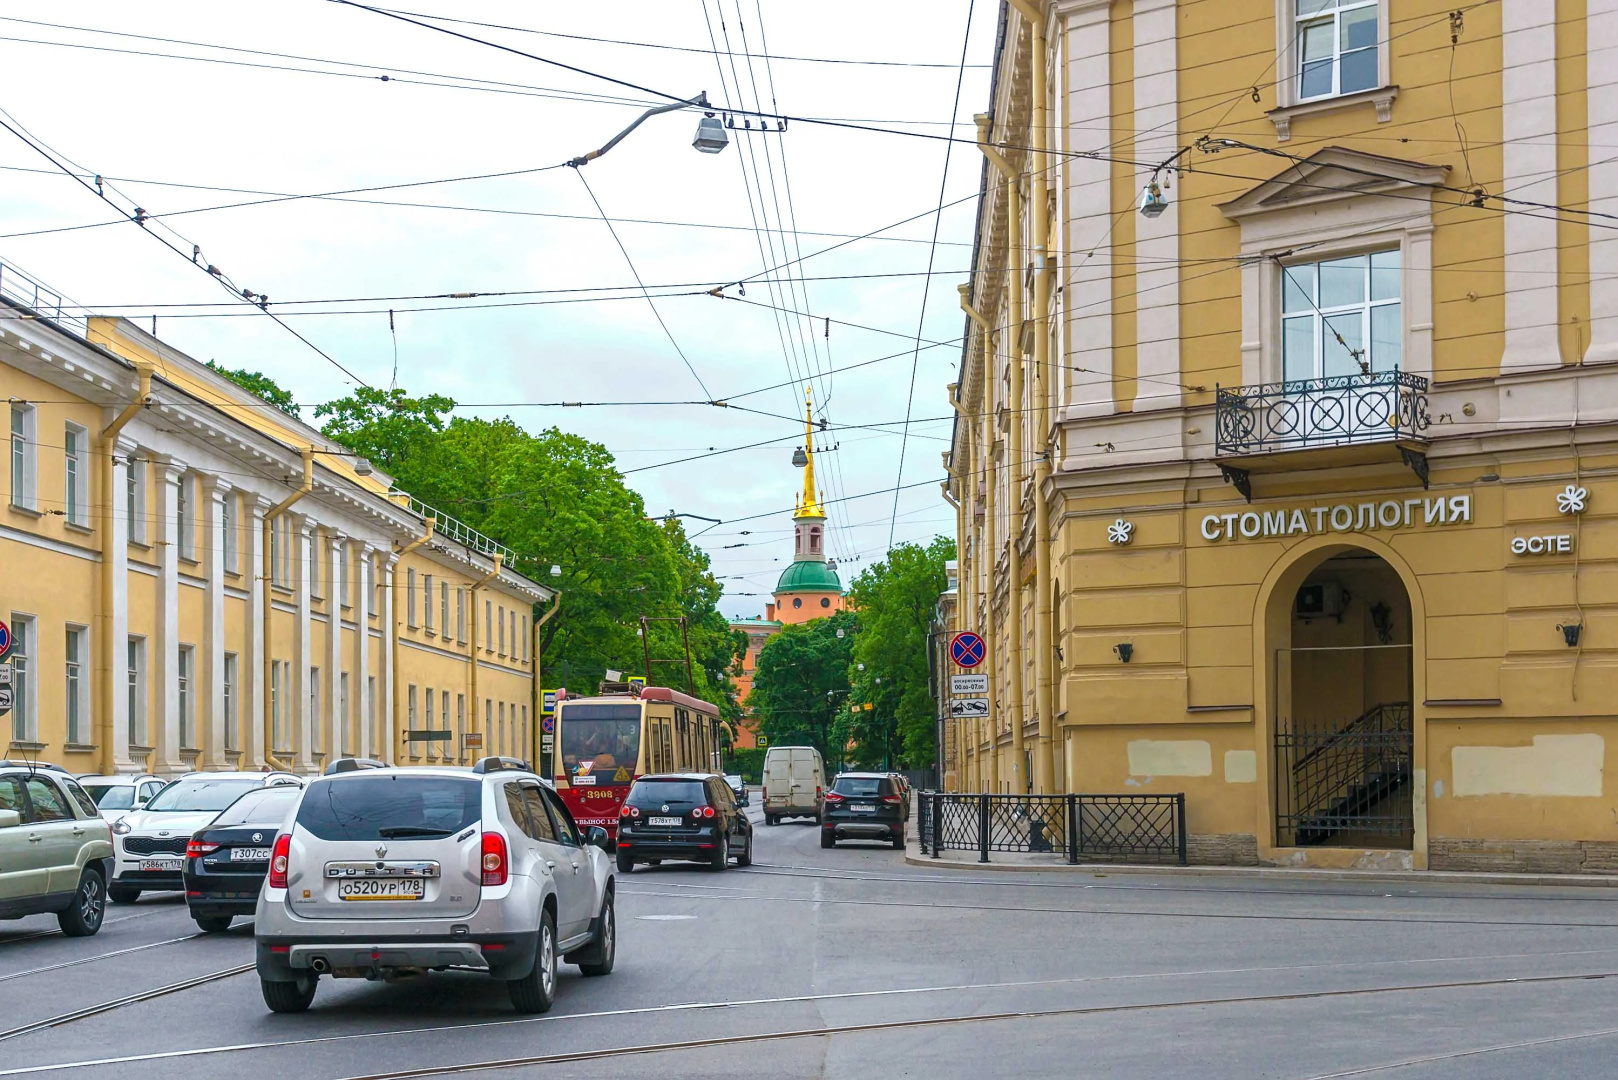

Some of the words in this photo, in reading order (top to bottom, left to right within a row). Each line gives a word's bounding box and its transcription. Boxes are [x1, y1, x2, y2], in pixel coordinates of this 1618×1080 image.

[1200, 496, 1471, 541] СТОМАТОЛОГИЯ
[1510, 534, 1571, 554] ЭСТЕ
[587, 790, 613, 799] 3908
[328, 867, 434, 876] DUSTER
[344, 880, 397, 894] О520УР
[400, 879, 420, 891] 178
